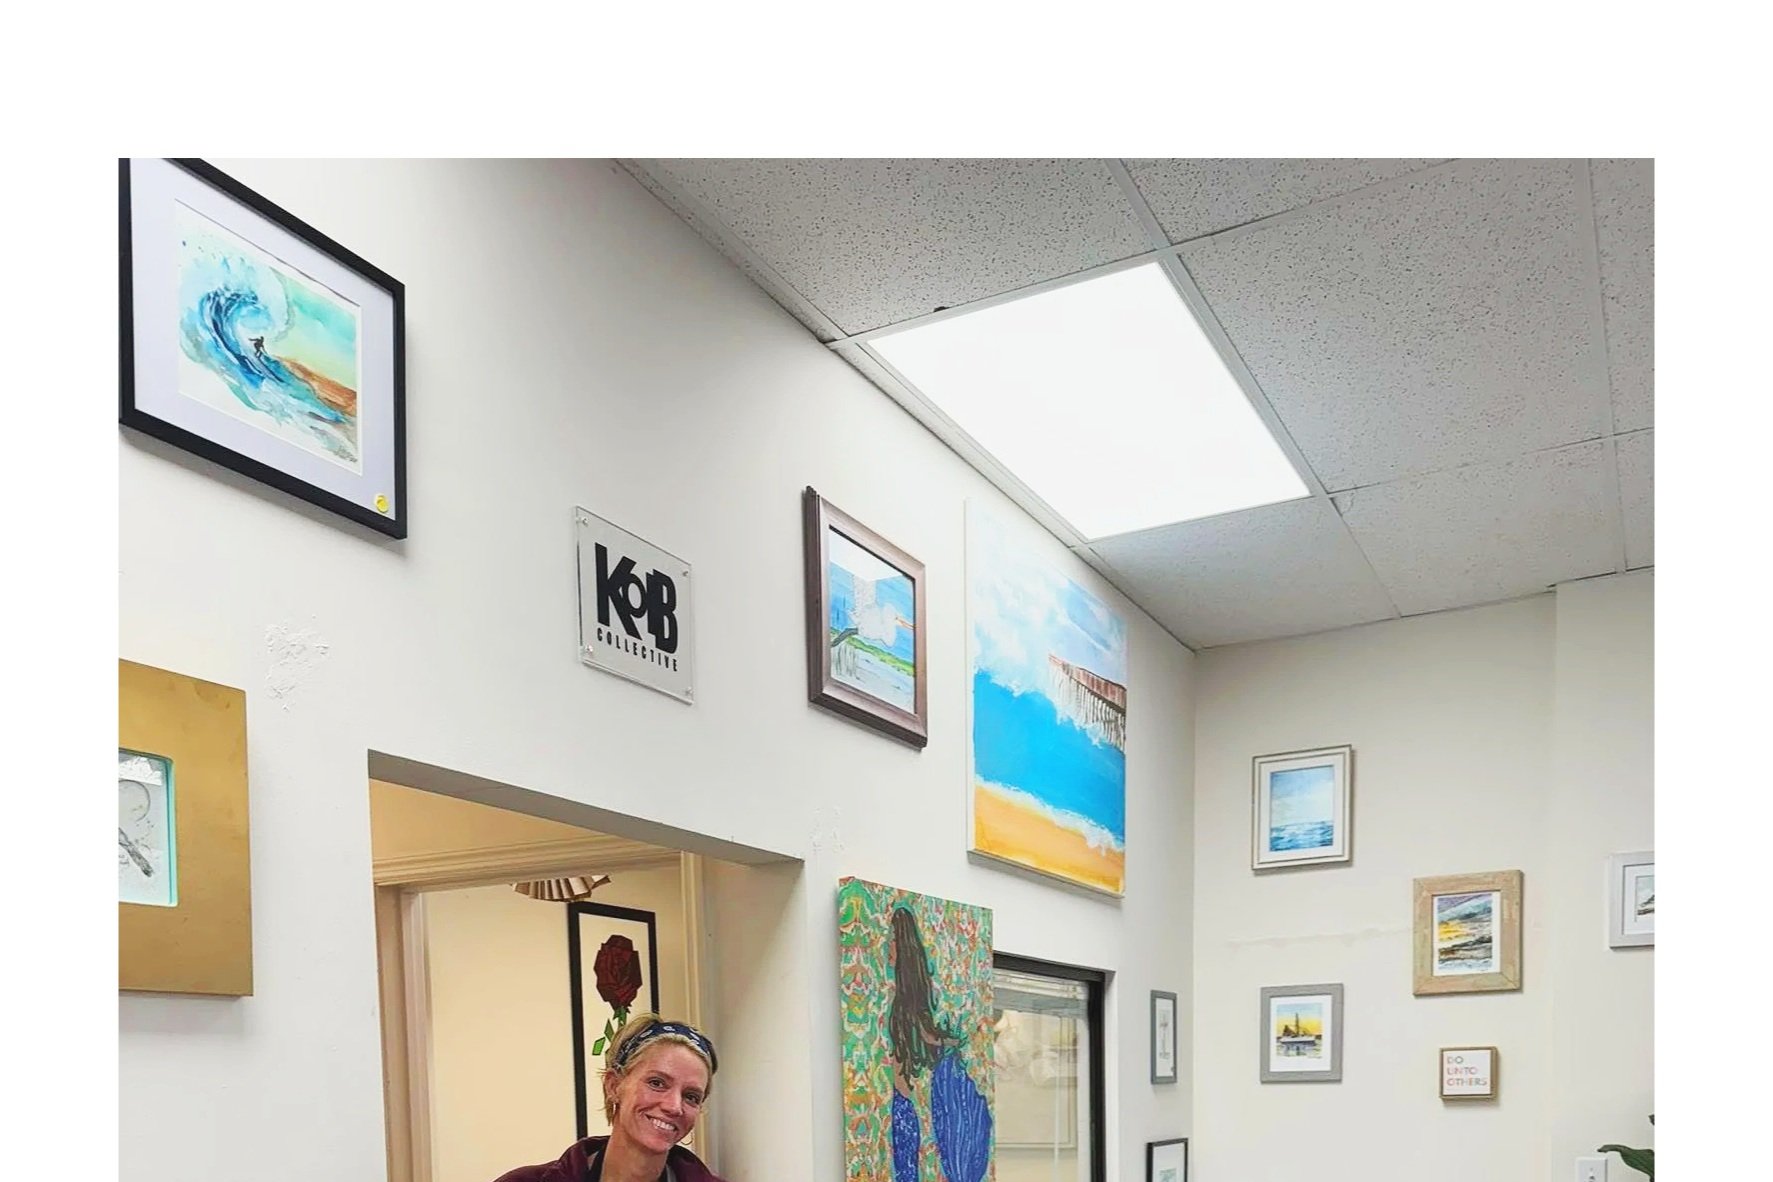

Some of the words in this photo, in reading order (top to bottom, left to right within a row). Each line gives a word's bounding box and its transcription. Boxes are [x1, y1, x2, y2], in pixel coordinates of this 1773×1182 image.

[597, 627, 678, 672] COLLECTIVE
[1447, 1056, 1464, 1064] DO
[1447, 1066, 1478, 1075] UNTO
[1447, 1078, 1487, 1086] OTHERS
